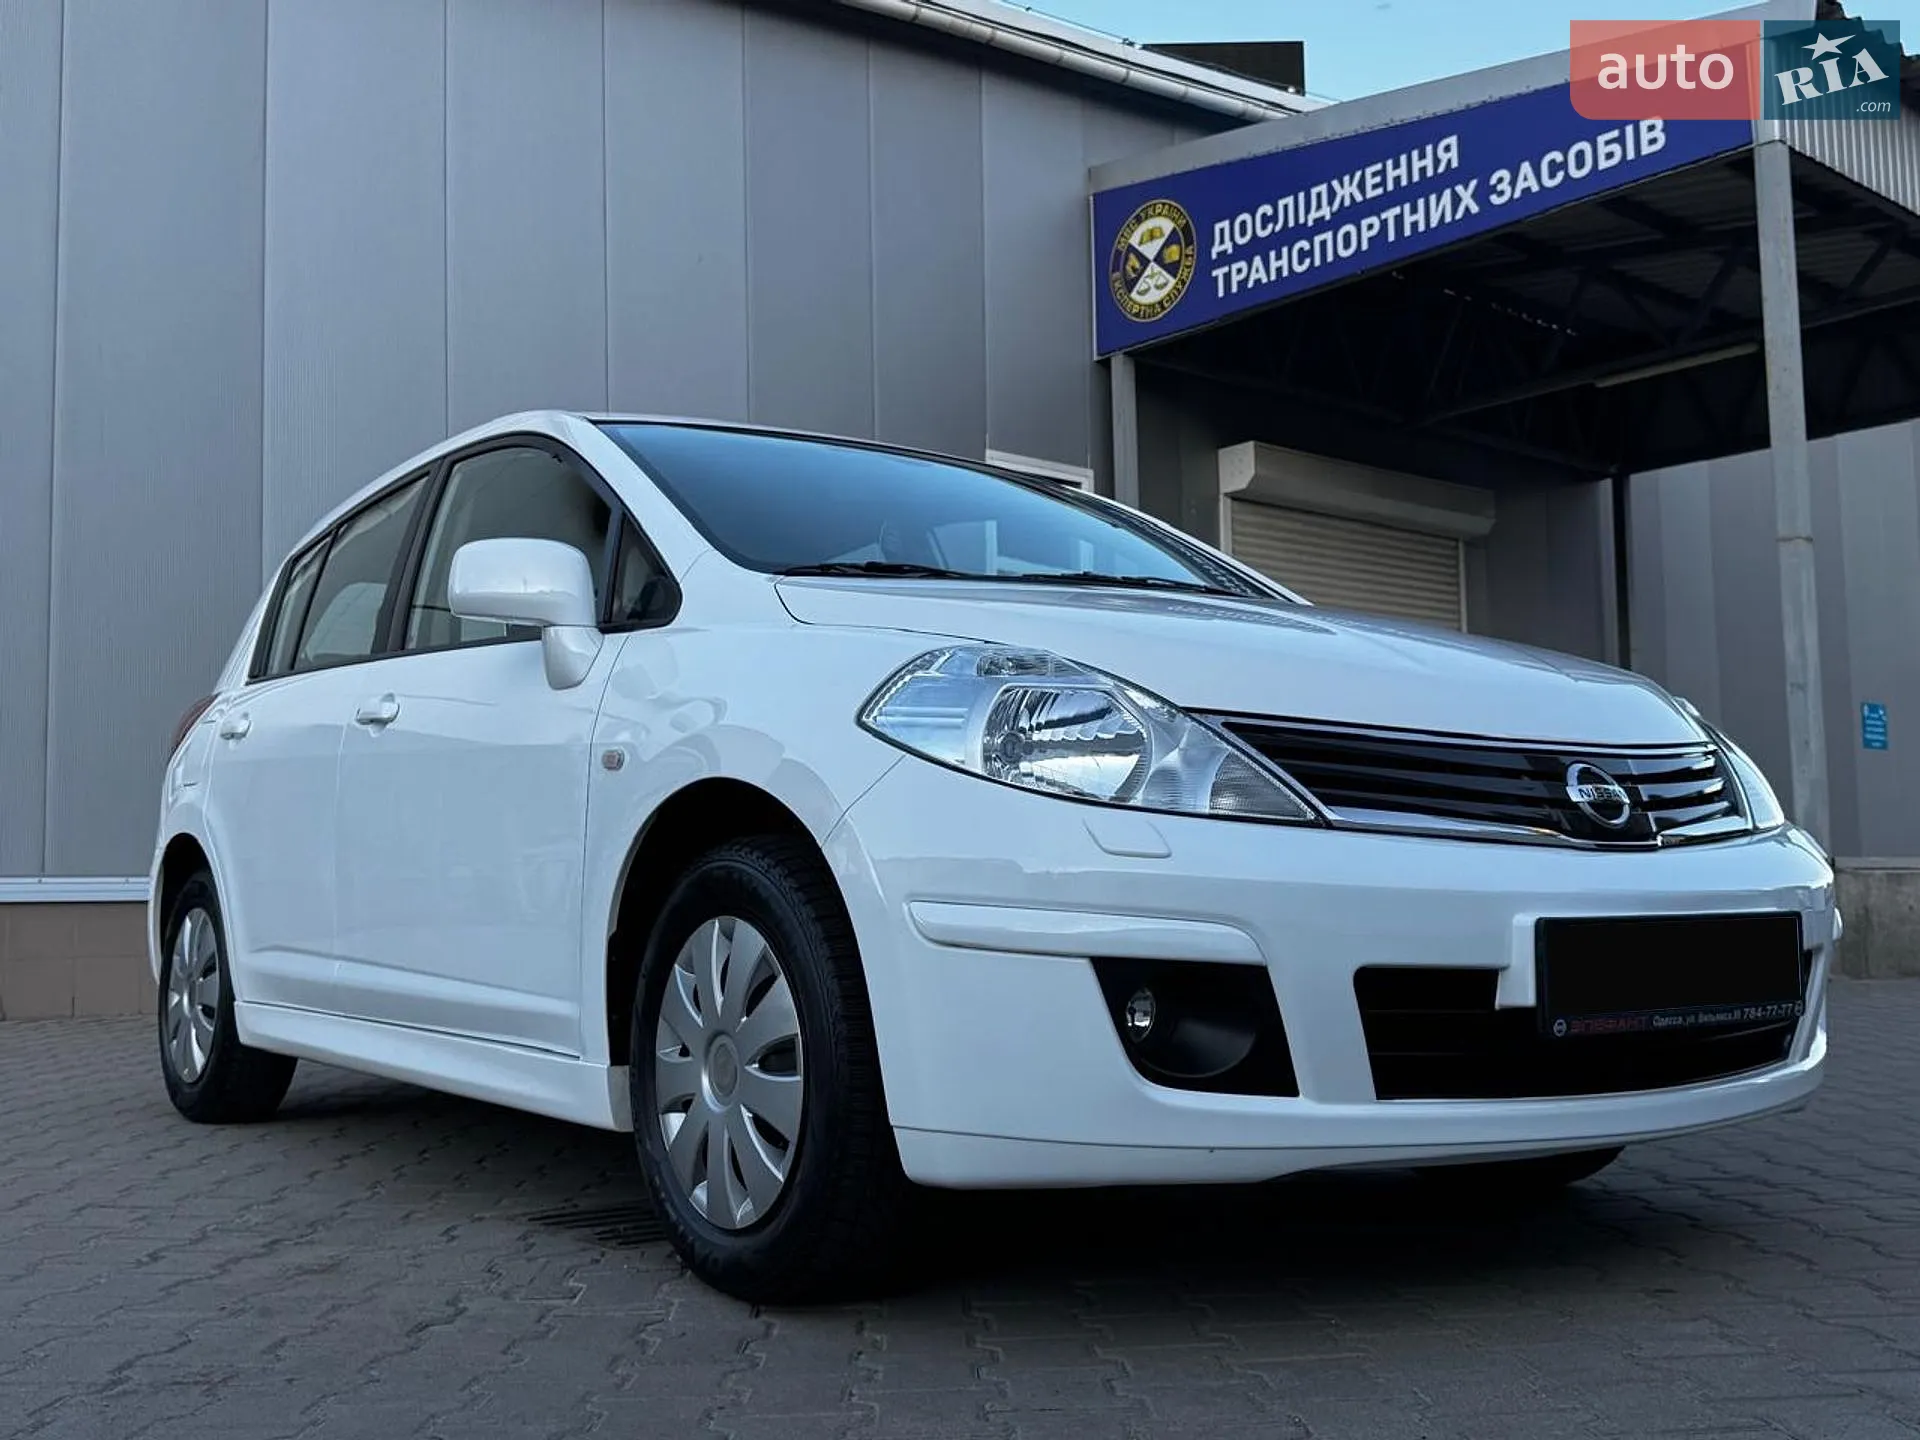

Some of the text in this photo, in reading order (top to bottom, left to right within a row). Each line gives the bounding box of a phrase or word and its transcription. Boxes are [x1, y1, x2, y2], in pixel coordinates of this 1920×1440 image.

[1211, 135, 1460, 259] ДОСЛІДЖЕННЯ
[1212, 116, 1667, 298] ТРАНСПОРТНИХ ЗАСОБІВ
[1578, 786, 1627, 801] NISSAN
